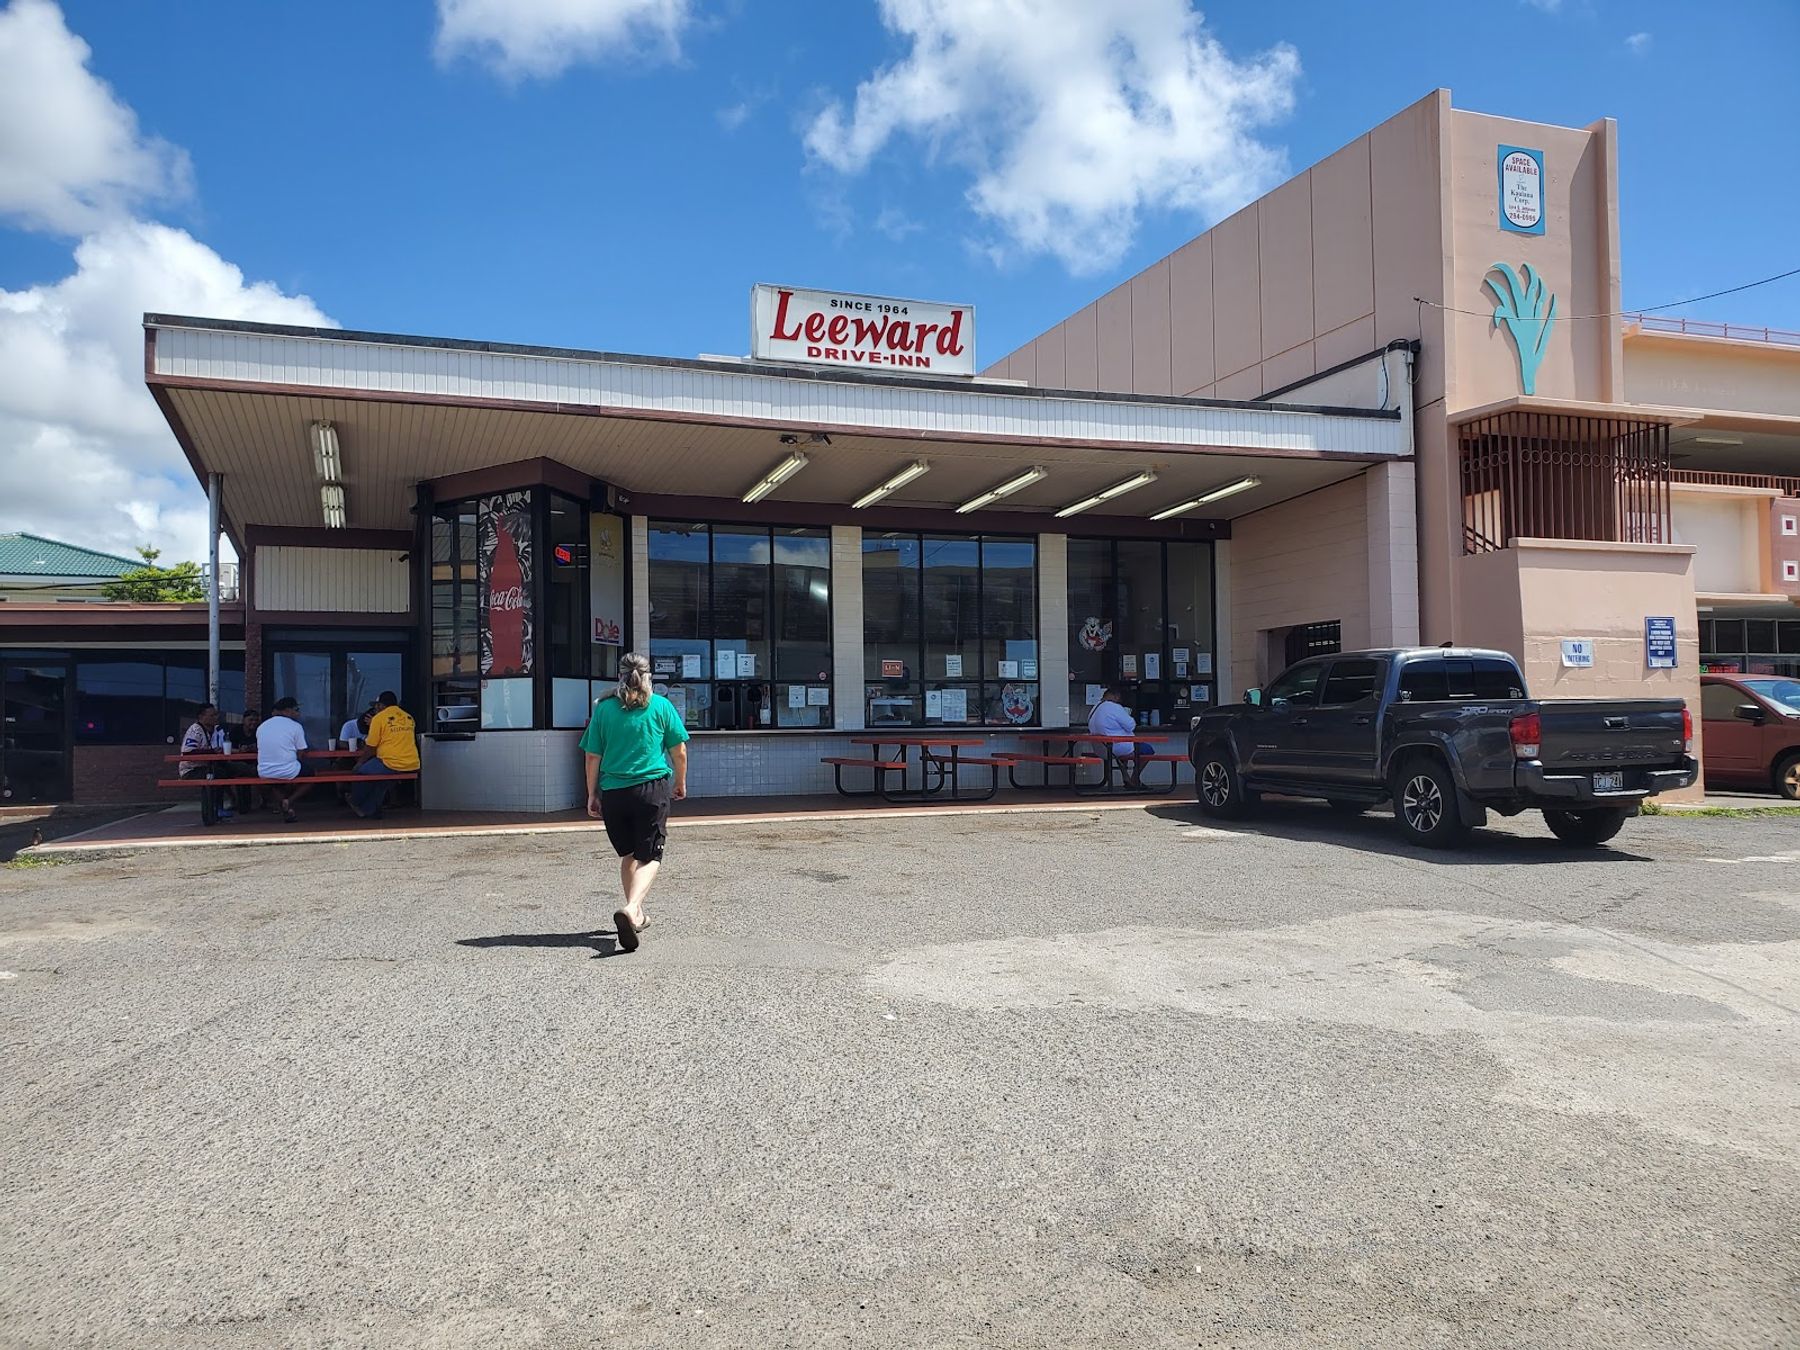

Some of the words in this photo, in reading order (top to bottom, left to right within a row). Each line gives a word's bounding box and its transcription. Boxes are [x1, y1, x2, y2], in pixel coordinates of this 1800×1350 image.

[1512, 157, 1531, 167] SPACE
[1505, 164, 1538, 176] AVAILABLE
[830, 299, 872, 312] SINCE
[877, 304, 909, 315] 1964
[769, 290, 964, 356] Leeward
[807, 346, 931, 368] DRIVE-INN
[1572, 643, 1582, 654] NO
[1570, 751, 1655, 761] TACOMA
